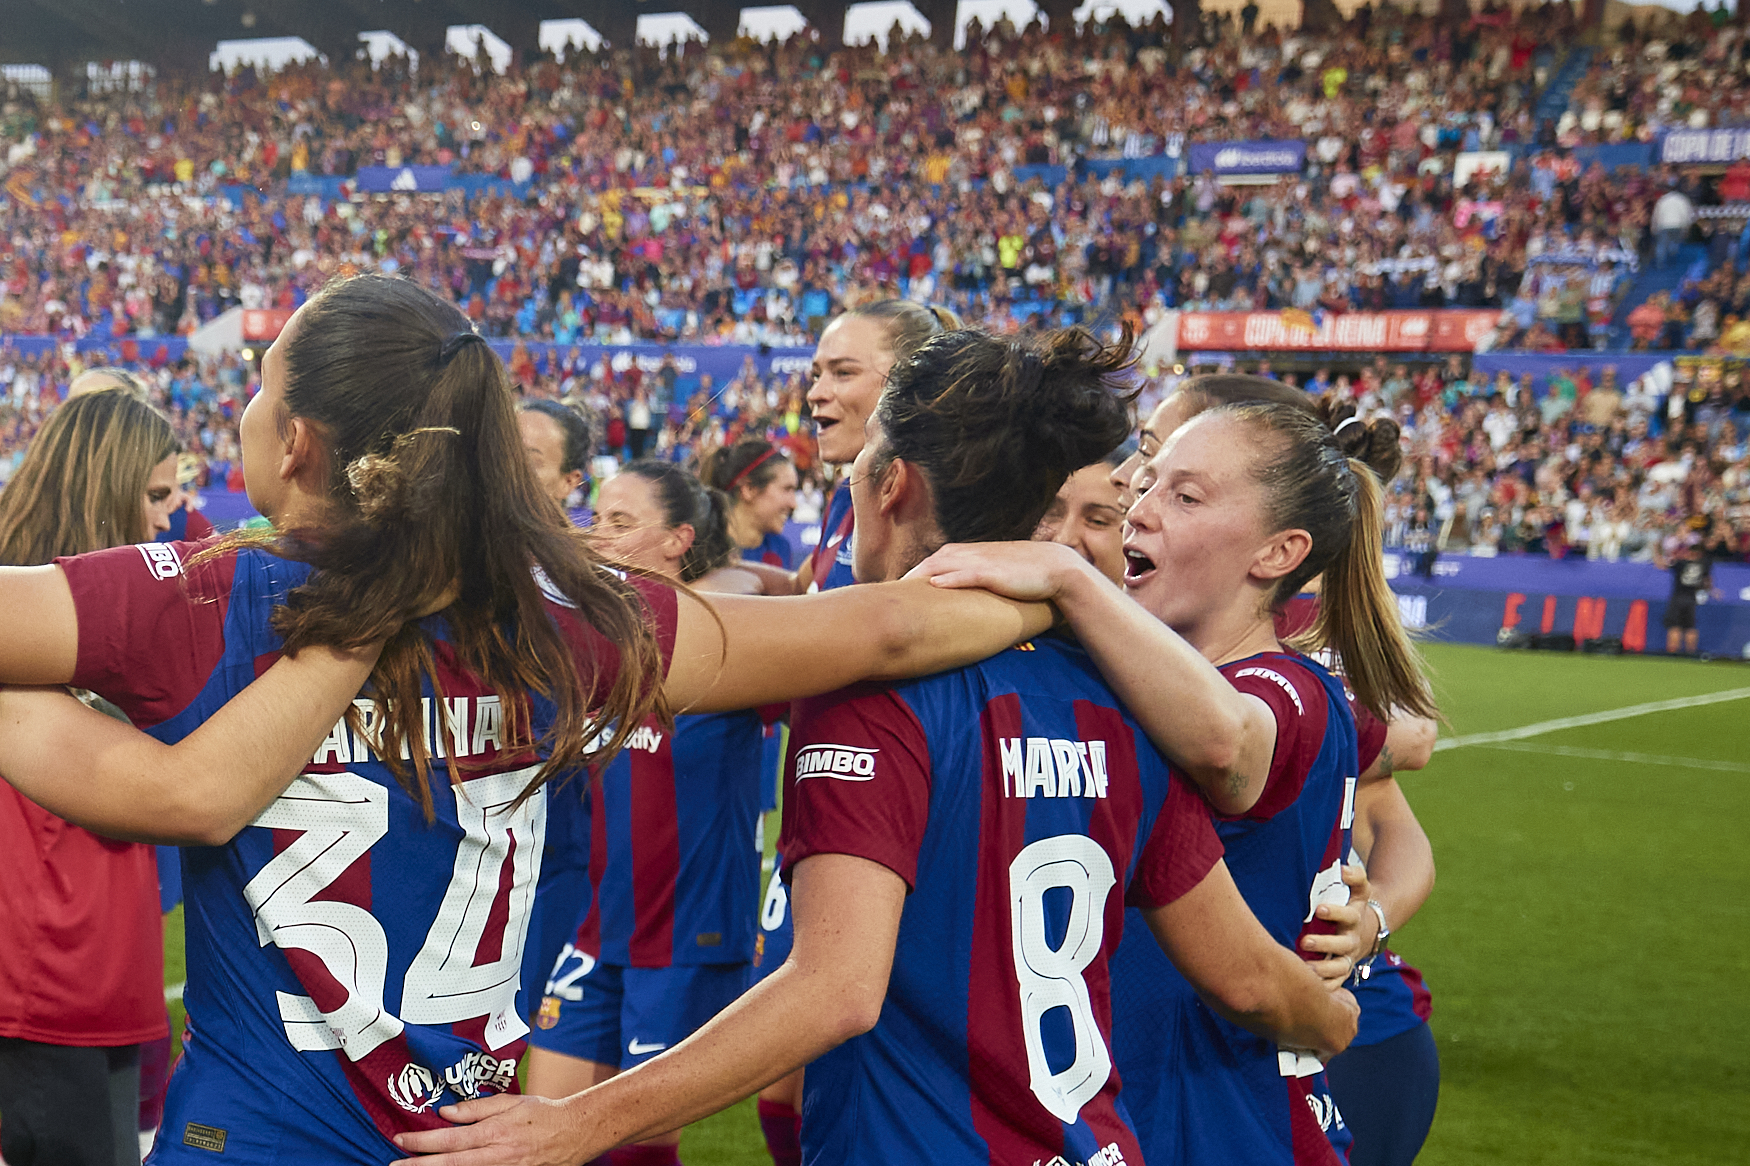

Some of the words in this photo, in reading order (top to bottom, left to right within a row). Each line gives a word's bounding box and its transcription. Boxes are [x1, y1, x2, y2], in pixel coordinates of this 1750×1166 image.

[308, 695, 503, 764] ARINA
[796, 750, 875, 778] BIMBO
[244, 763, 547, 1063] 34
[1009, 834, 1117, 1125] 8
